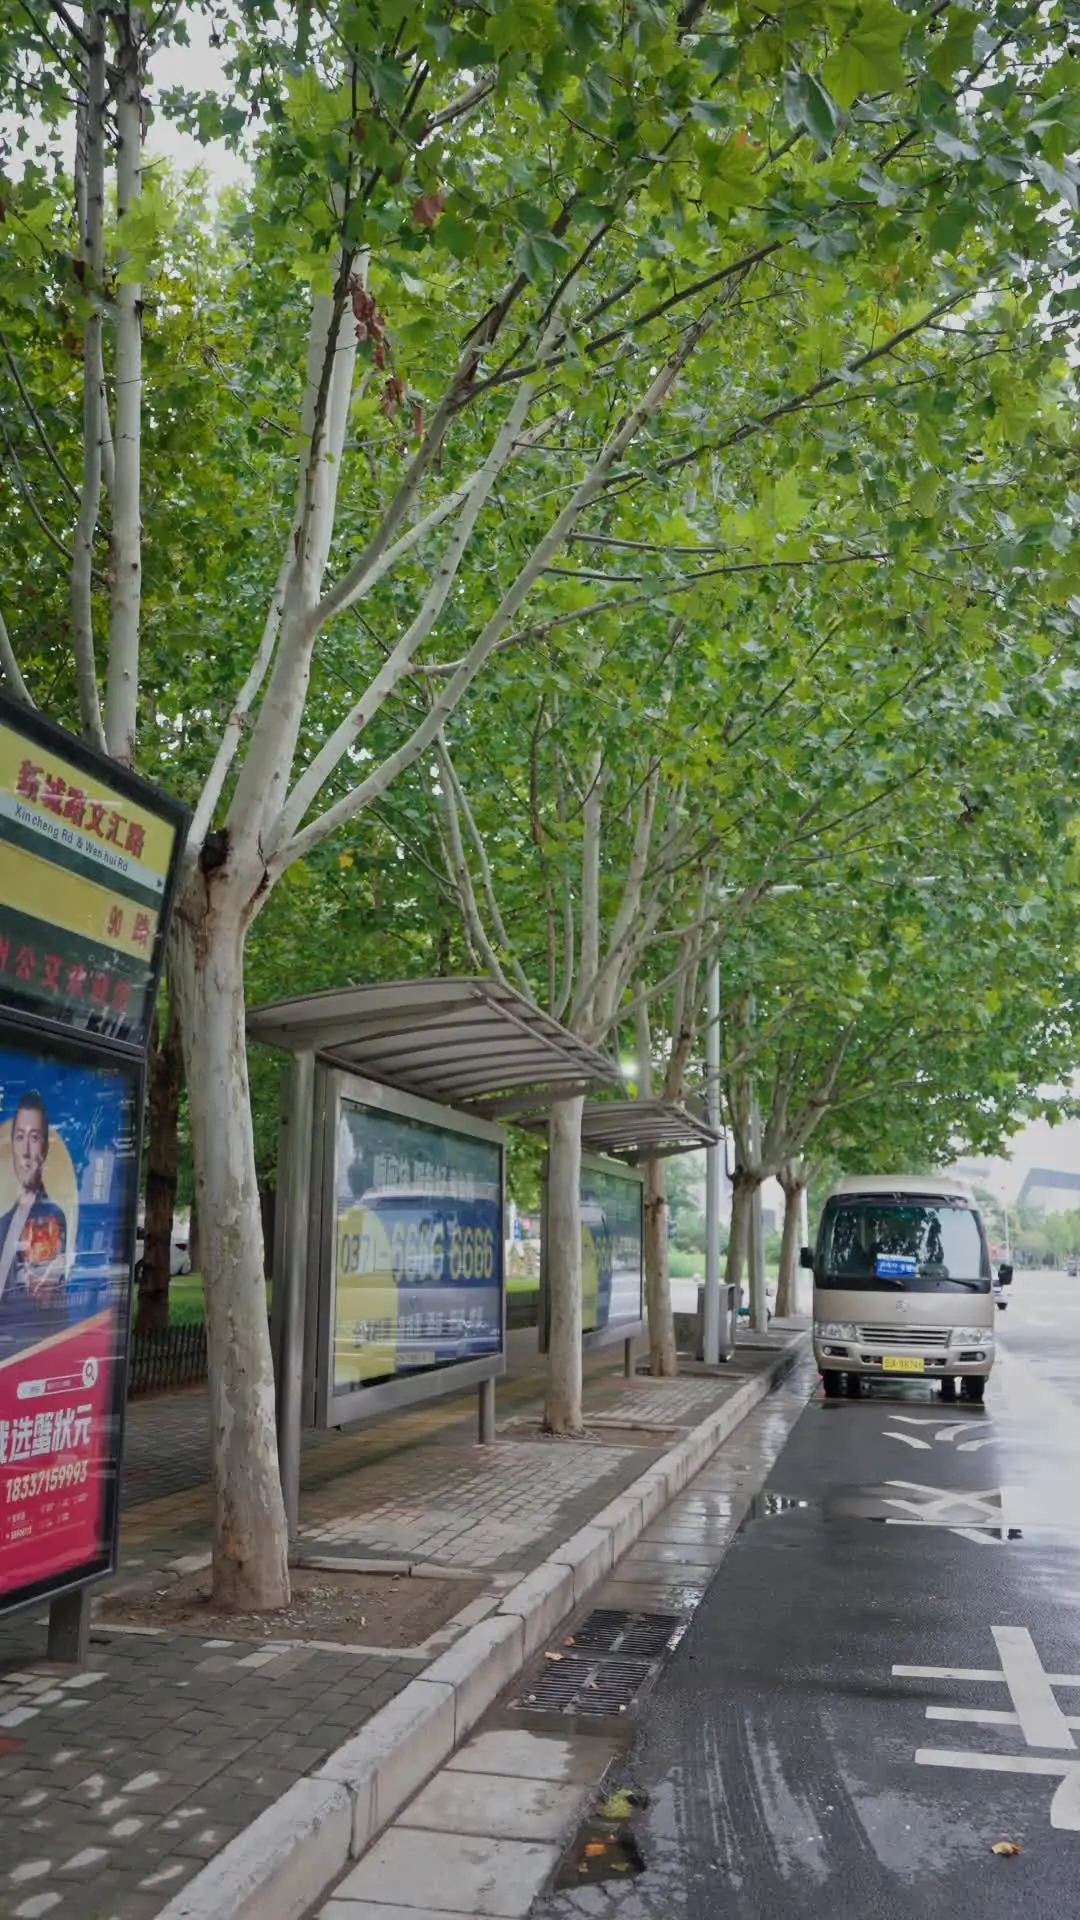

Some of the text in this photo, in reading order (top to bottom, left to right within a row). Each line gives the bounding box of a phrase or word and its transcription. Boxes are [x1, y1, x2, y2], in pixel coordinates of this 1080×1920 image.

[16, 759, 146, 859] 新城路文汇路
[61, 829, 73, 844] Rd
[76, 838, 83, 850] &
[118, 857, 128, 872] Rd
[6, 1459, 88, 1504] 18337159993
